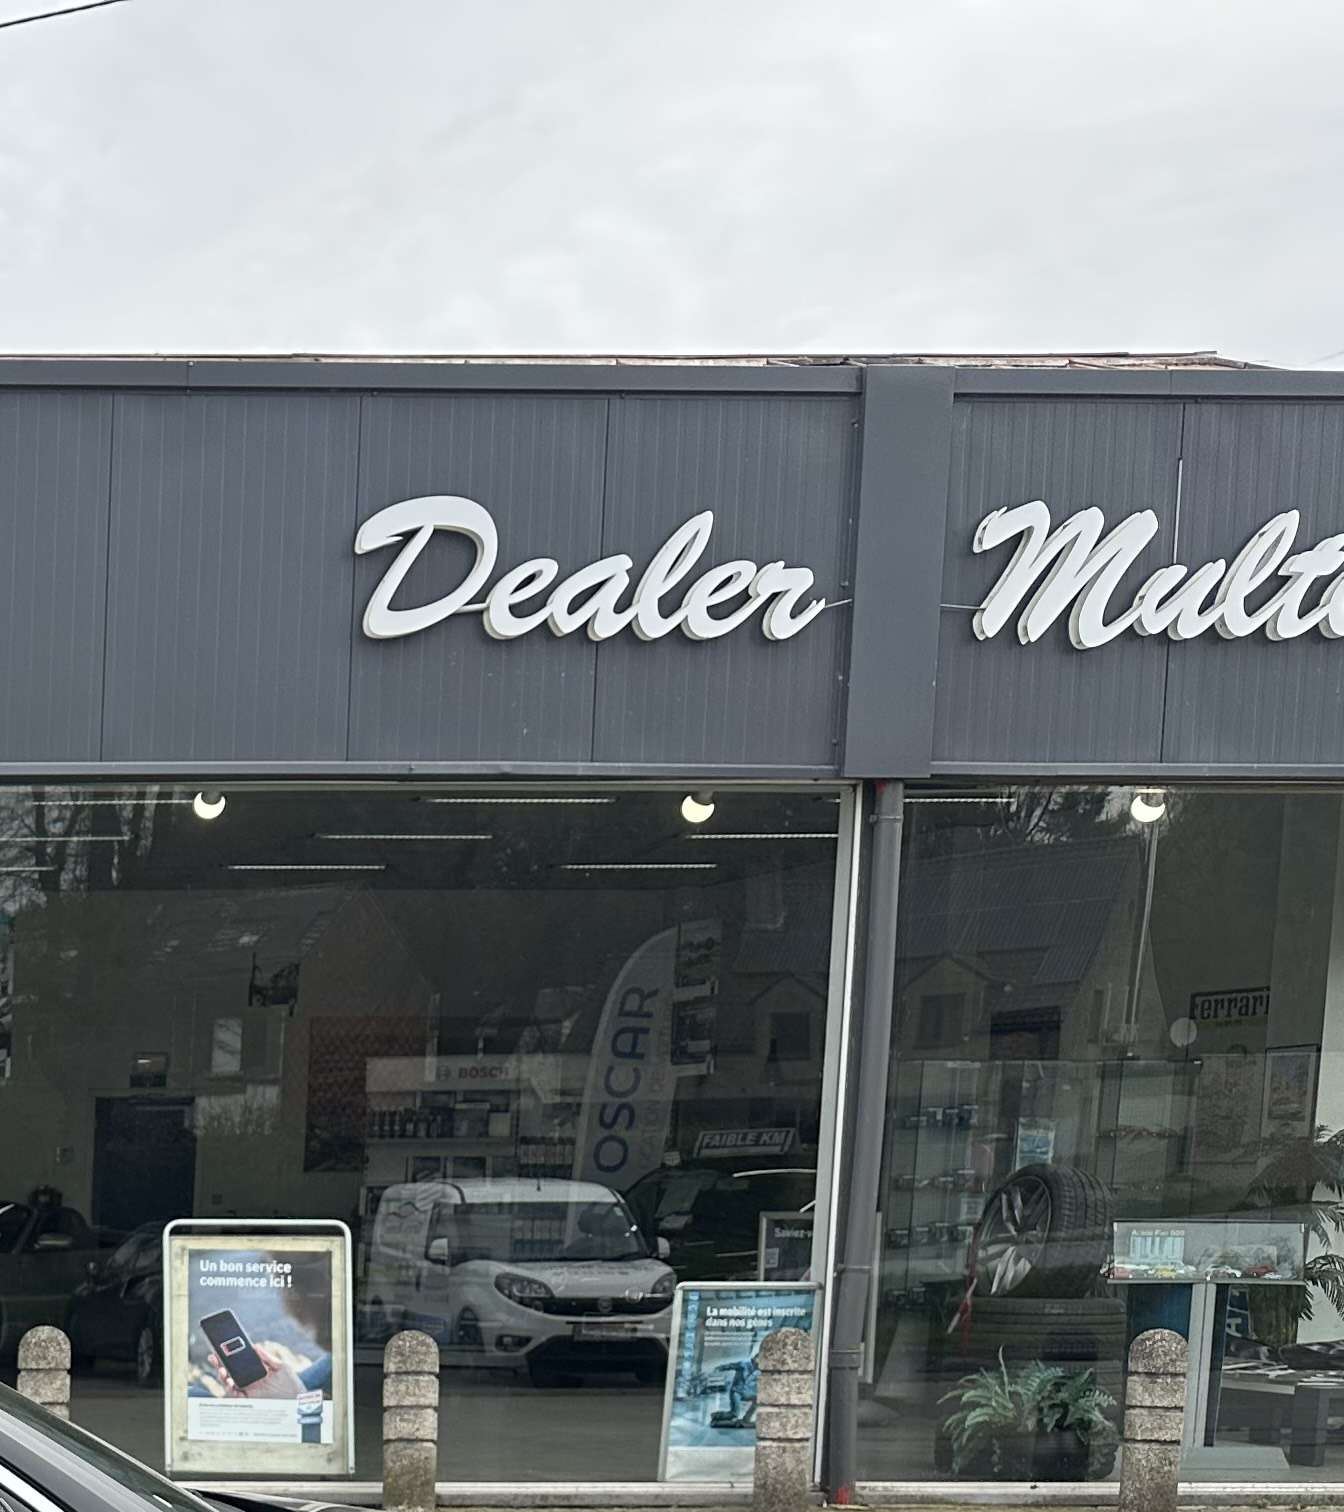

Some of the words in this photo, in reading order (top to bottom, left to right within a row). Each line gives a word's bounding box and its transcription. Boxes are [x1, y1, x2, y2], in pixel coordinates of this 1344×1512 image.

[353, 494, 827, 641] Dealer
[592, 985, 660, 1174] OSCAR
[702, 1133, 758, 1147] FAIBLE
[759, 1132, 786, 1145] KM
[199, 1260, 217, 1273] Un
[220, 1260, 243, 1273] bon
[245, 1260, 292, 1273] service
[199, 1276, 267, 1287] commence
[269, 1275, 285, 1287] ici
[706, 1306, 718, 1316] La
[705, 1317, 728, 1327] dans
[729, 1318, 745, 1327] nos
